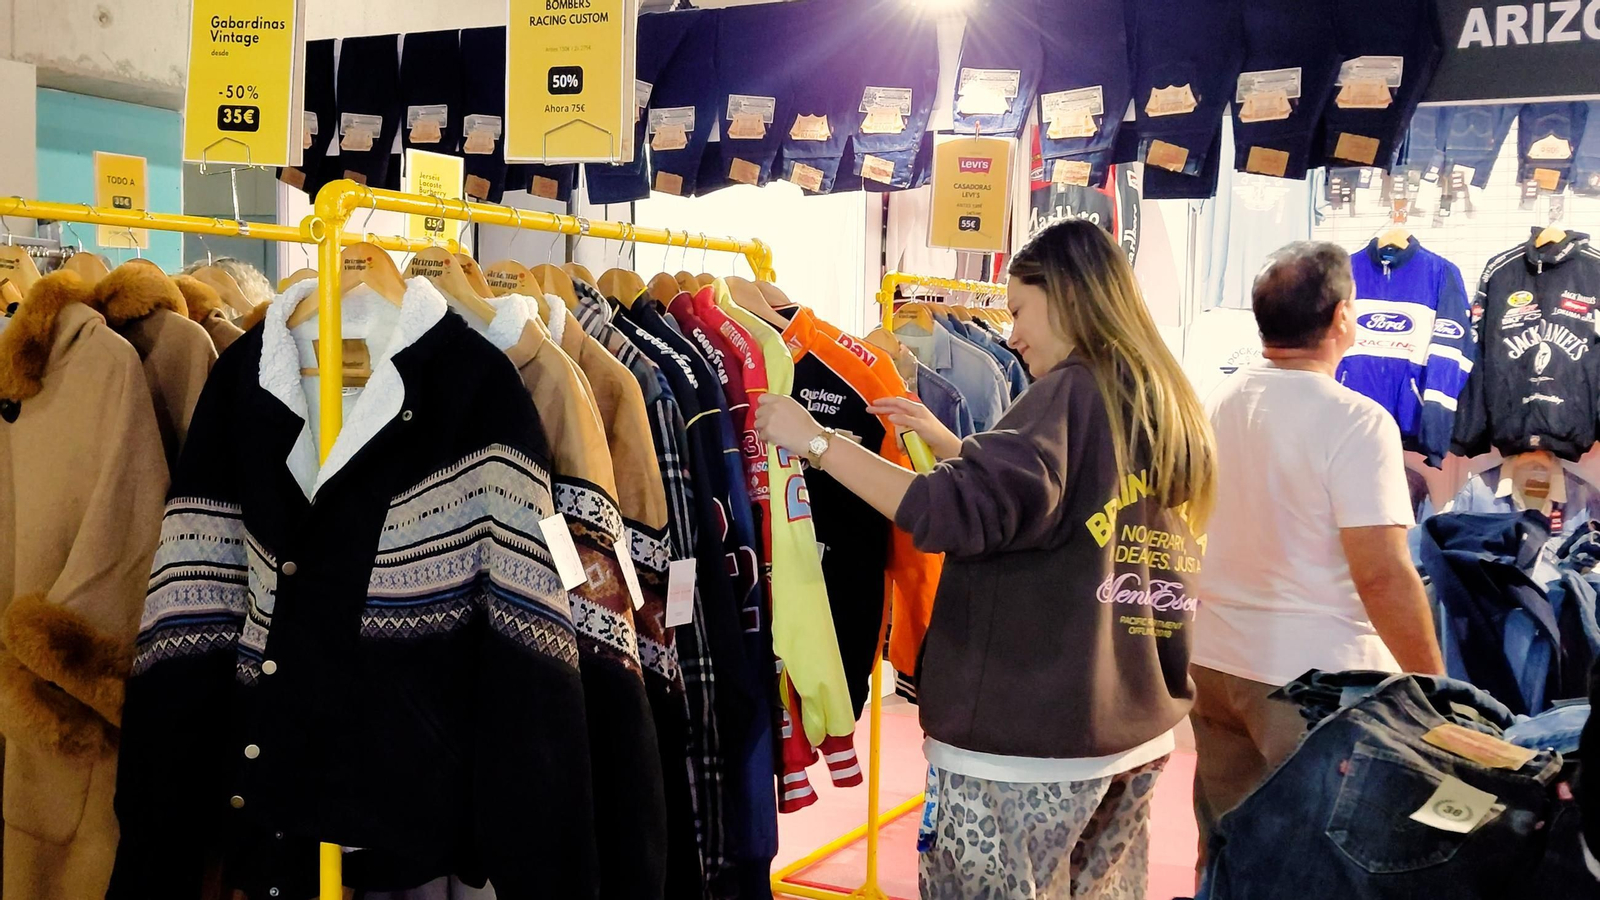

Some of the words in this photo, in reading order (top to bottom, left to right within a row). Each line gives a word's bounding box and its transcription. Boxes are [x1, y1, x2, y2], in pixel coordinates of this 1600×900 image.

[545, 0, 591, 10] BOMBERS
[211, 15, 286, 29] Gabardinas
[529, 14, 567, 26] RACING
[569, 12, 609, 25] CUSTOM
[210, 29, 259, 47] Vintage
[552, 74, 579, 88] 50%
[219, 85, 259, 99] -50%
[544, 104, 569, 113] Ahora
[571, 103, 586, 112] 75€
[223, 108, 255, 124] 35€
[107, 175, 128, 186] TODO
[130, 178, 136, 186] A
[953, 183, 992, 191] CASADORAS
[961, 220, 976, 228] 55€
[412, 258, 444, 267] Arizona
[411, 267, 443, 277] Vintage
[1366, 313, 1407, 331] Ford
[1503, 325, 1542, 359] JACK
